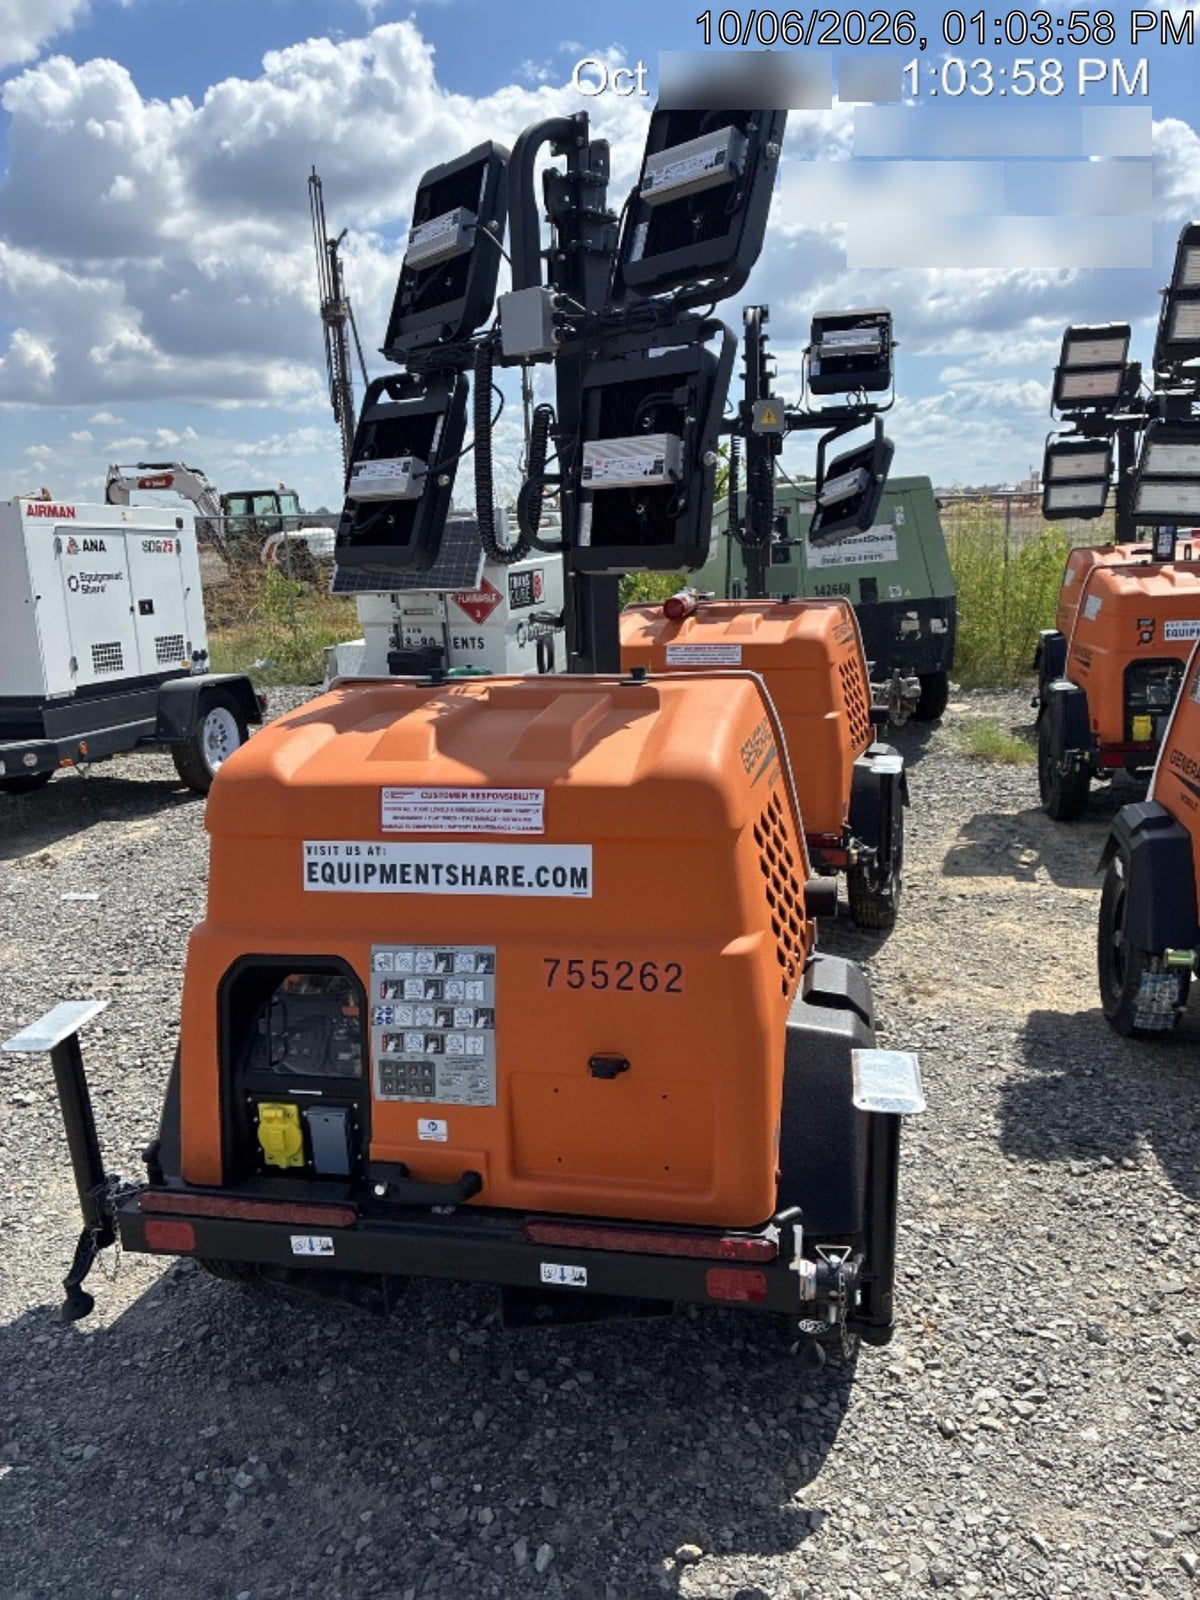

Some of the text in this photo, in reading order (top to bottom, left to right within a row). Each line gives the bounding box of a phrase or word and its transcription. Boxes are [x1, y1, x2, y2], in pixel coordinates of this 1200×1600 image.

[26, 504, 76, 519] AIRMAN
[82, 538, 107, 553] ANA
[305, 845, 339, 856] VISIT
[346, 846, 361, 856] US
[306, 861, 589, 890] EQUIPMENTSHARE.COM
[543, 957, 684, 994] 755262
